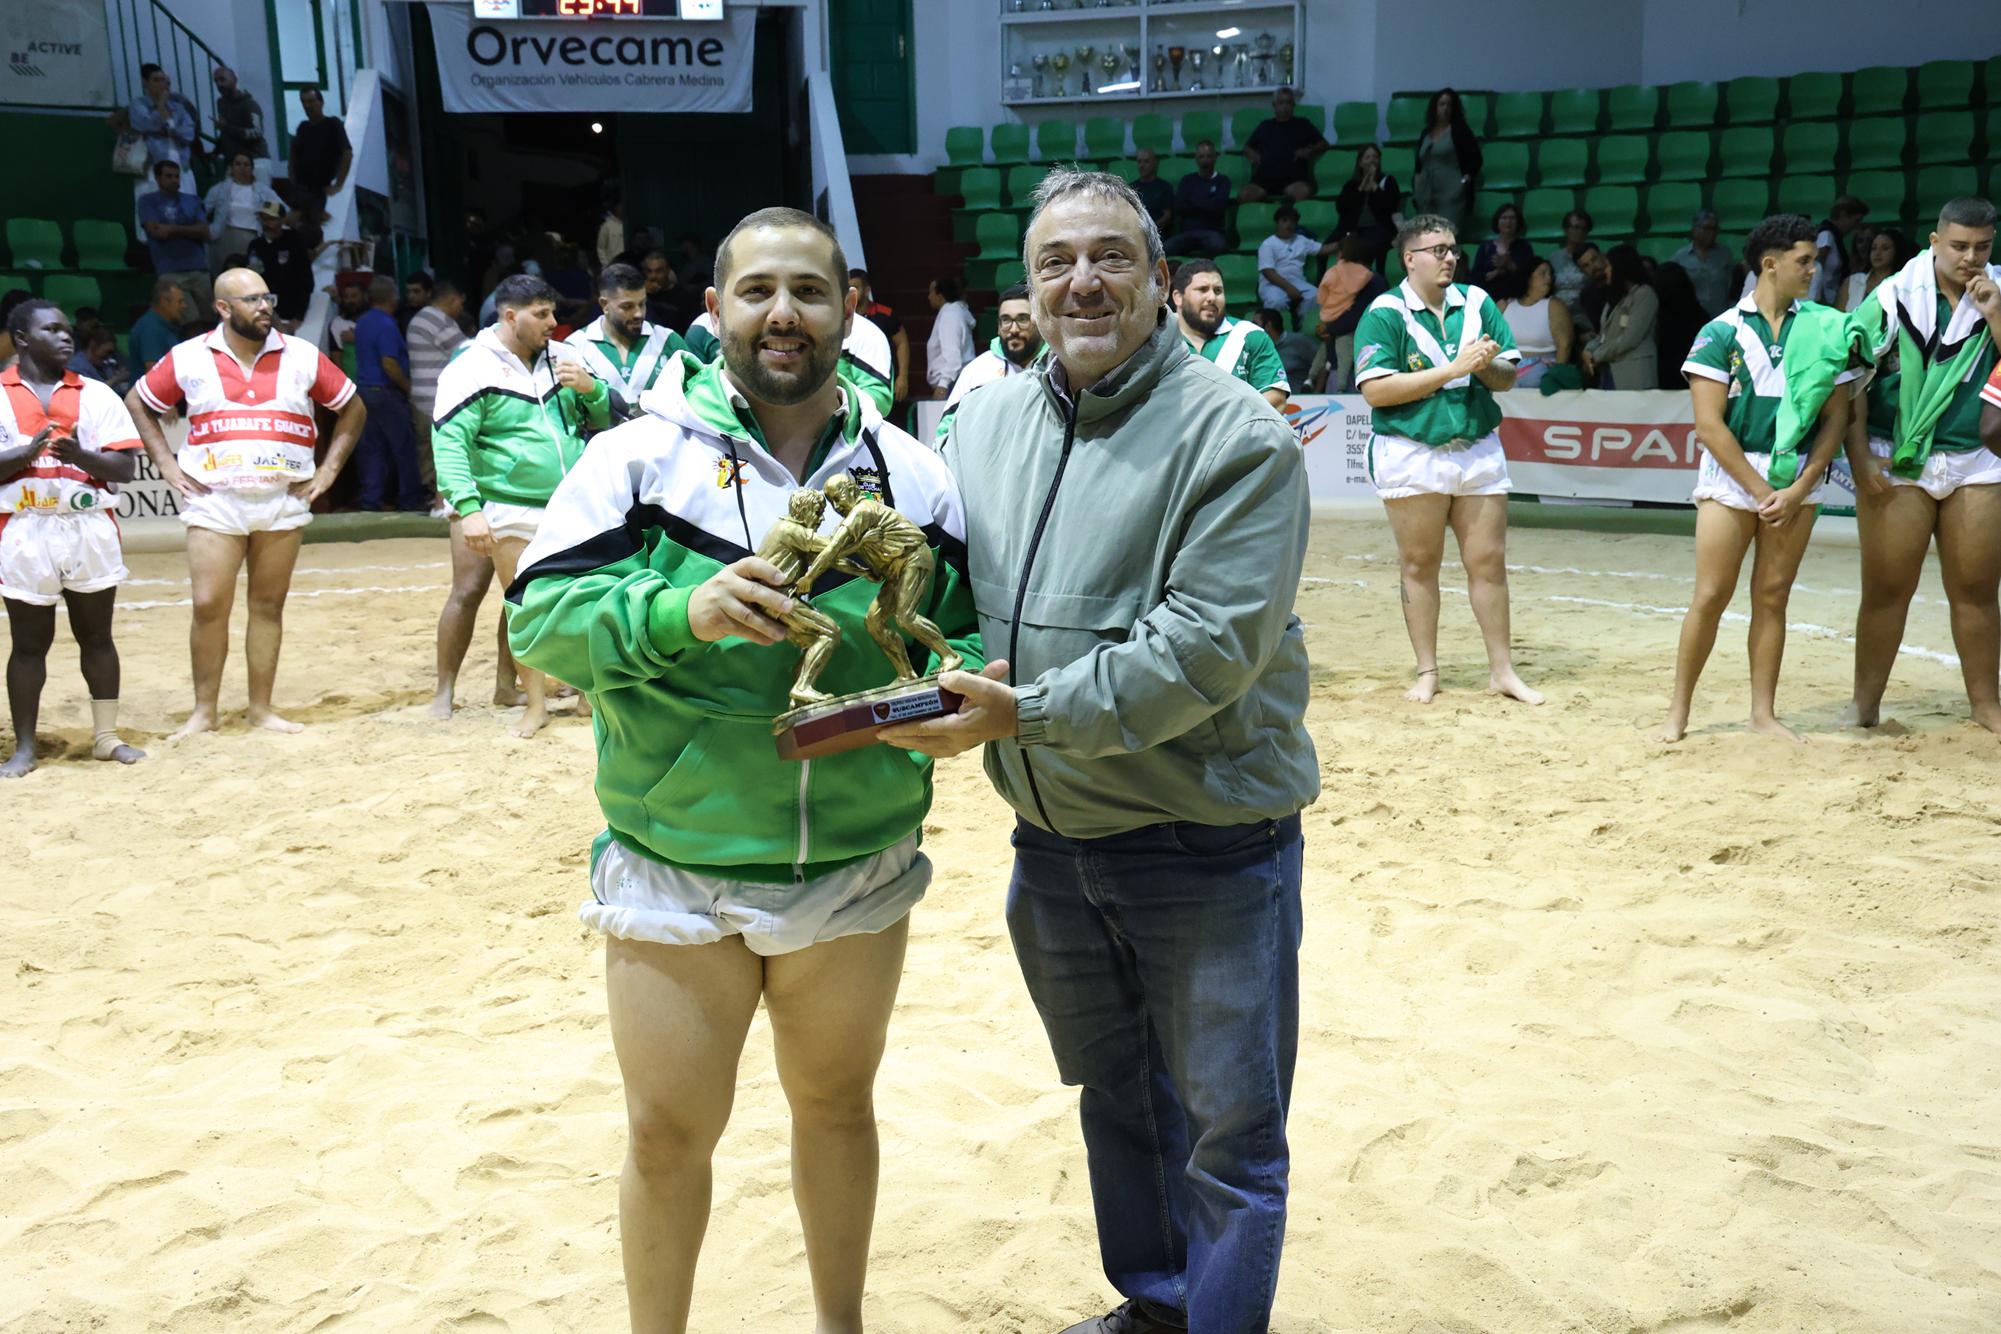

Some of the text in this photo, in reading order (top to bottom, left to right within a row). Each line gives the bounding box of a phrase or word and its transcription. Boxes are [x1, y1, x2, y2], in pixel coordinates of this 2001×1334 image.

[28, 41, 82, 56] ACTIVE
[467, 25, 724, 67] Orvecame
[10, 52, 29, 64] BE
[471, 72, 555, 90] Organización
[624, 73, 676, 87] Cabrera
[679, 74, 724, 87] Medina
[211, 417, 272, 433] TIJARAFE
[892, 699, 939, 713] SUBCAMPEÓN
